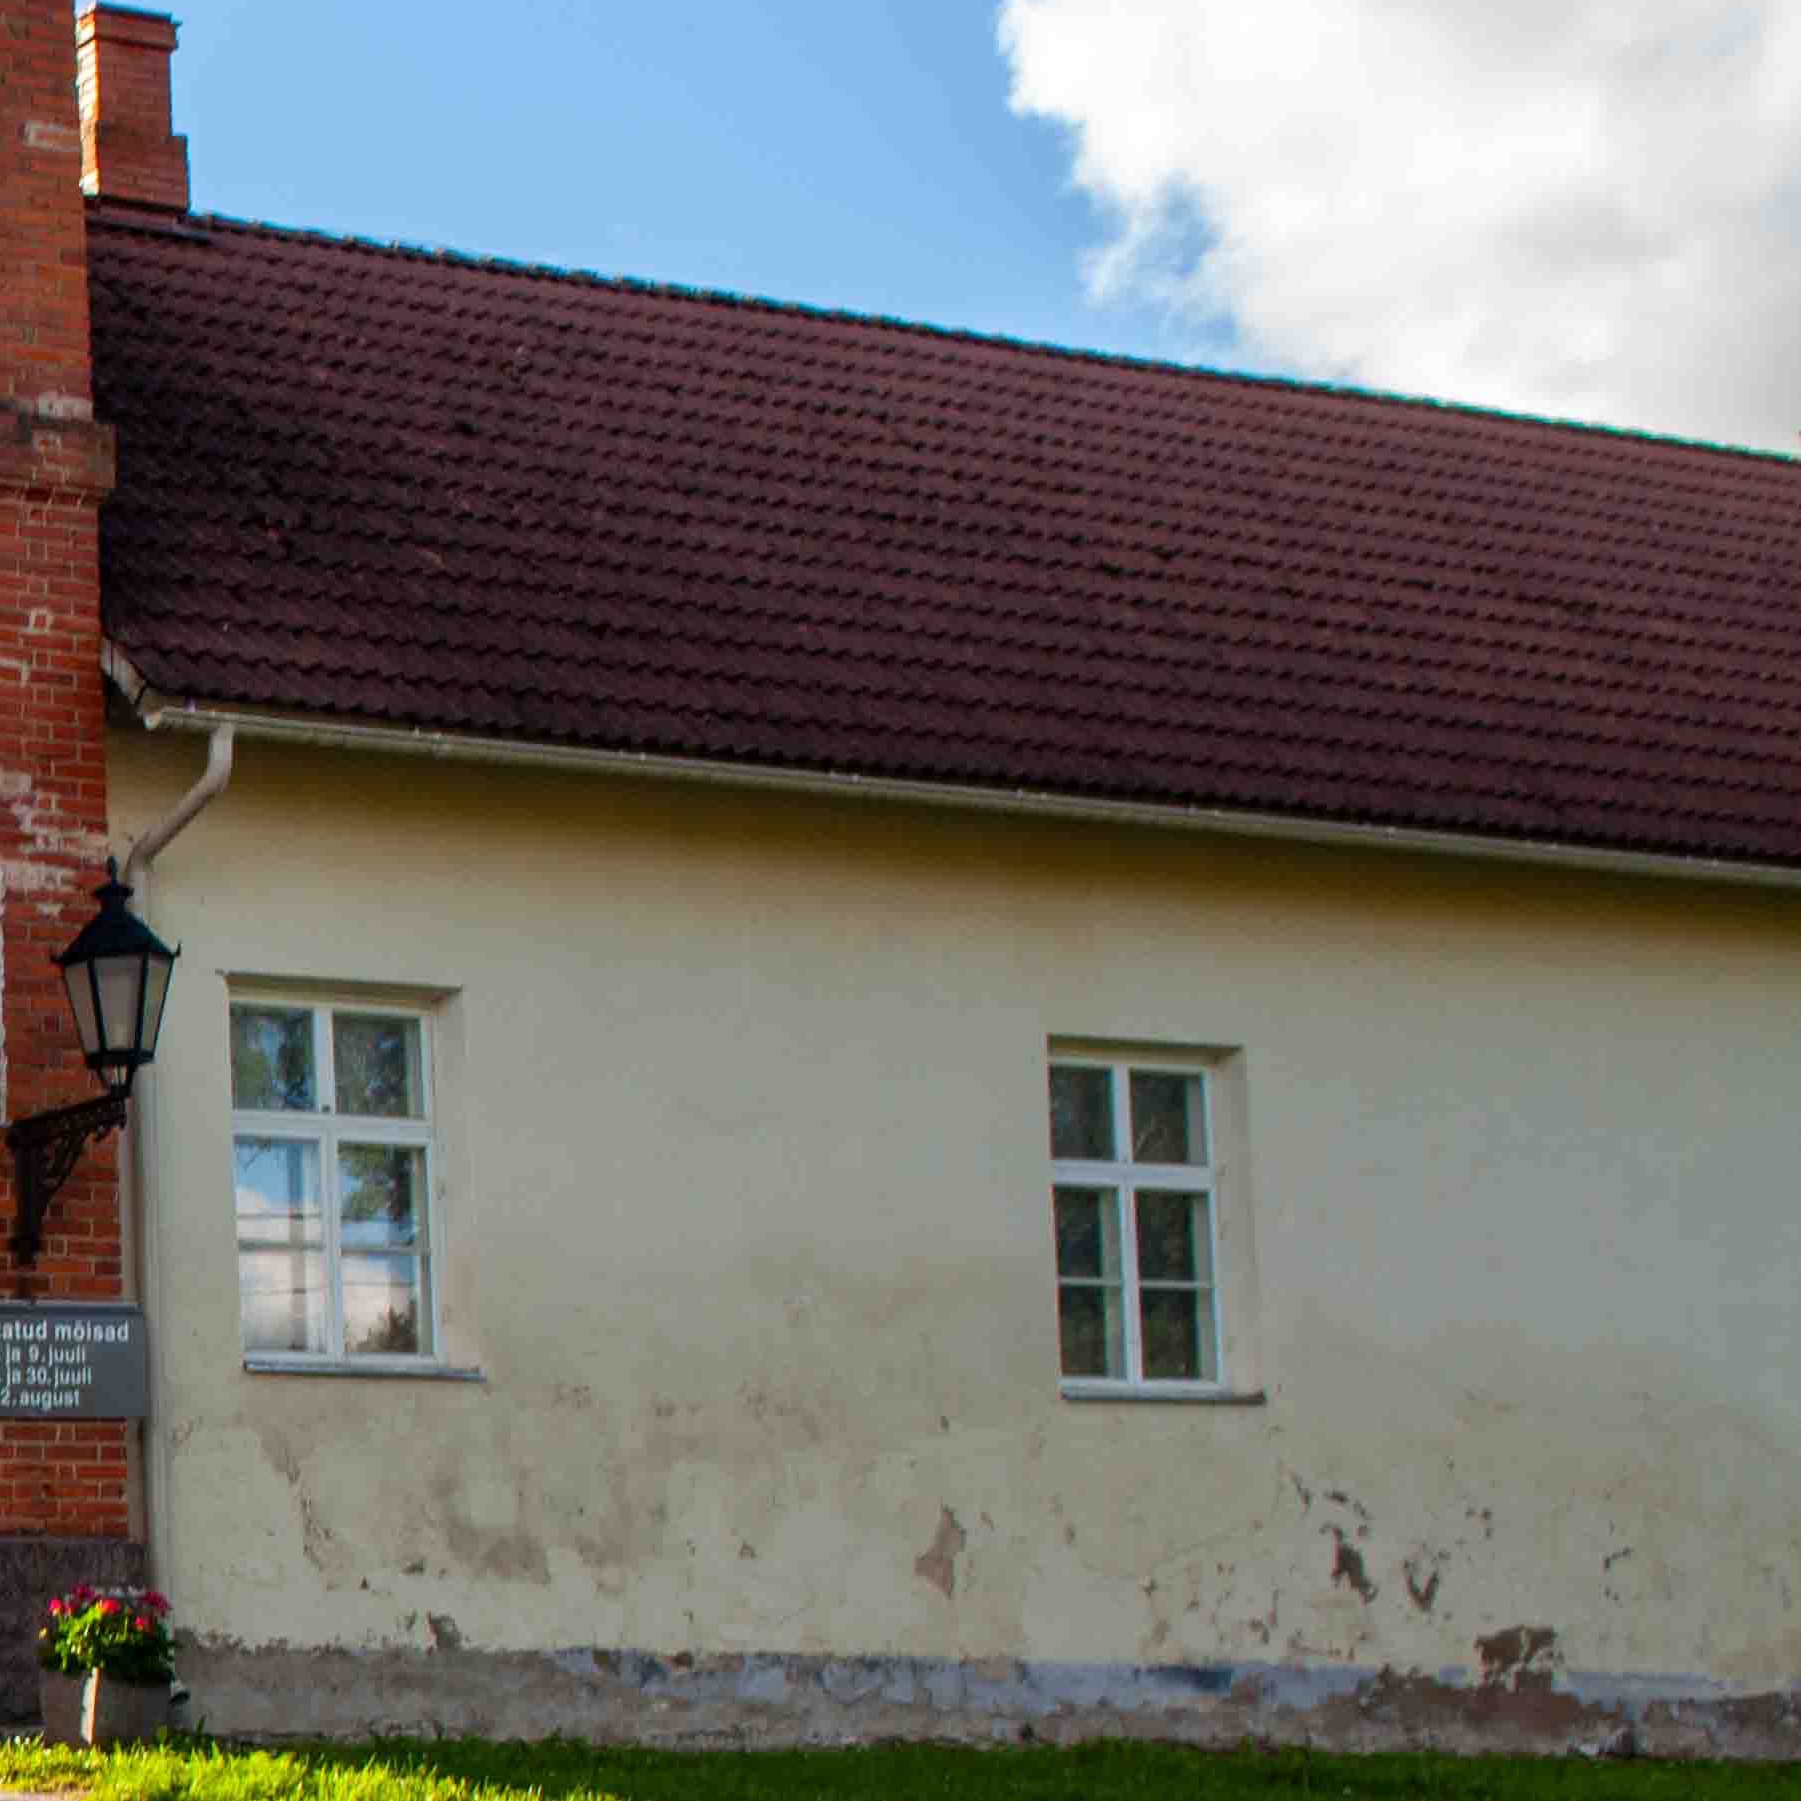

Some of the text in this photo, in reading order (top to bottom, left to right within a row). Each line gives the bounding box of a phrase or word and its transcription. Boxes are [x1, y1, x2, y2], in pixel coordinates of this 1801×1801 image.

[54, 1319, 129, 1342] mõisad
[5, 1344, 21, 1367] ja
[5, 1367, 21, 1388] ja
